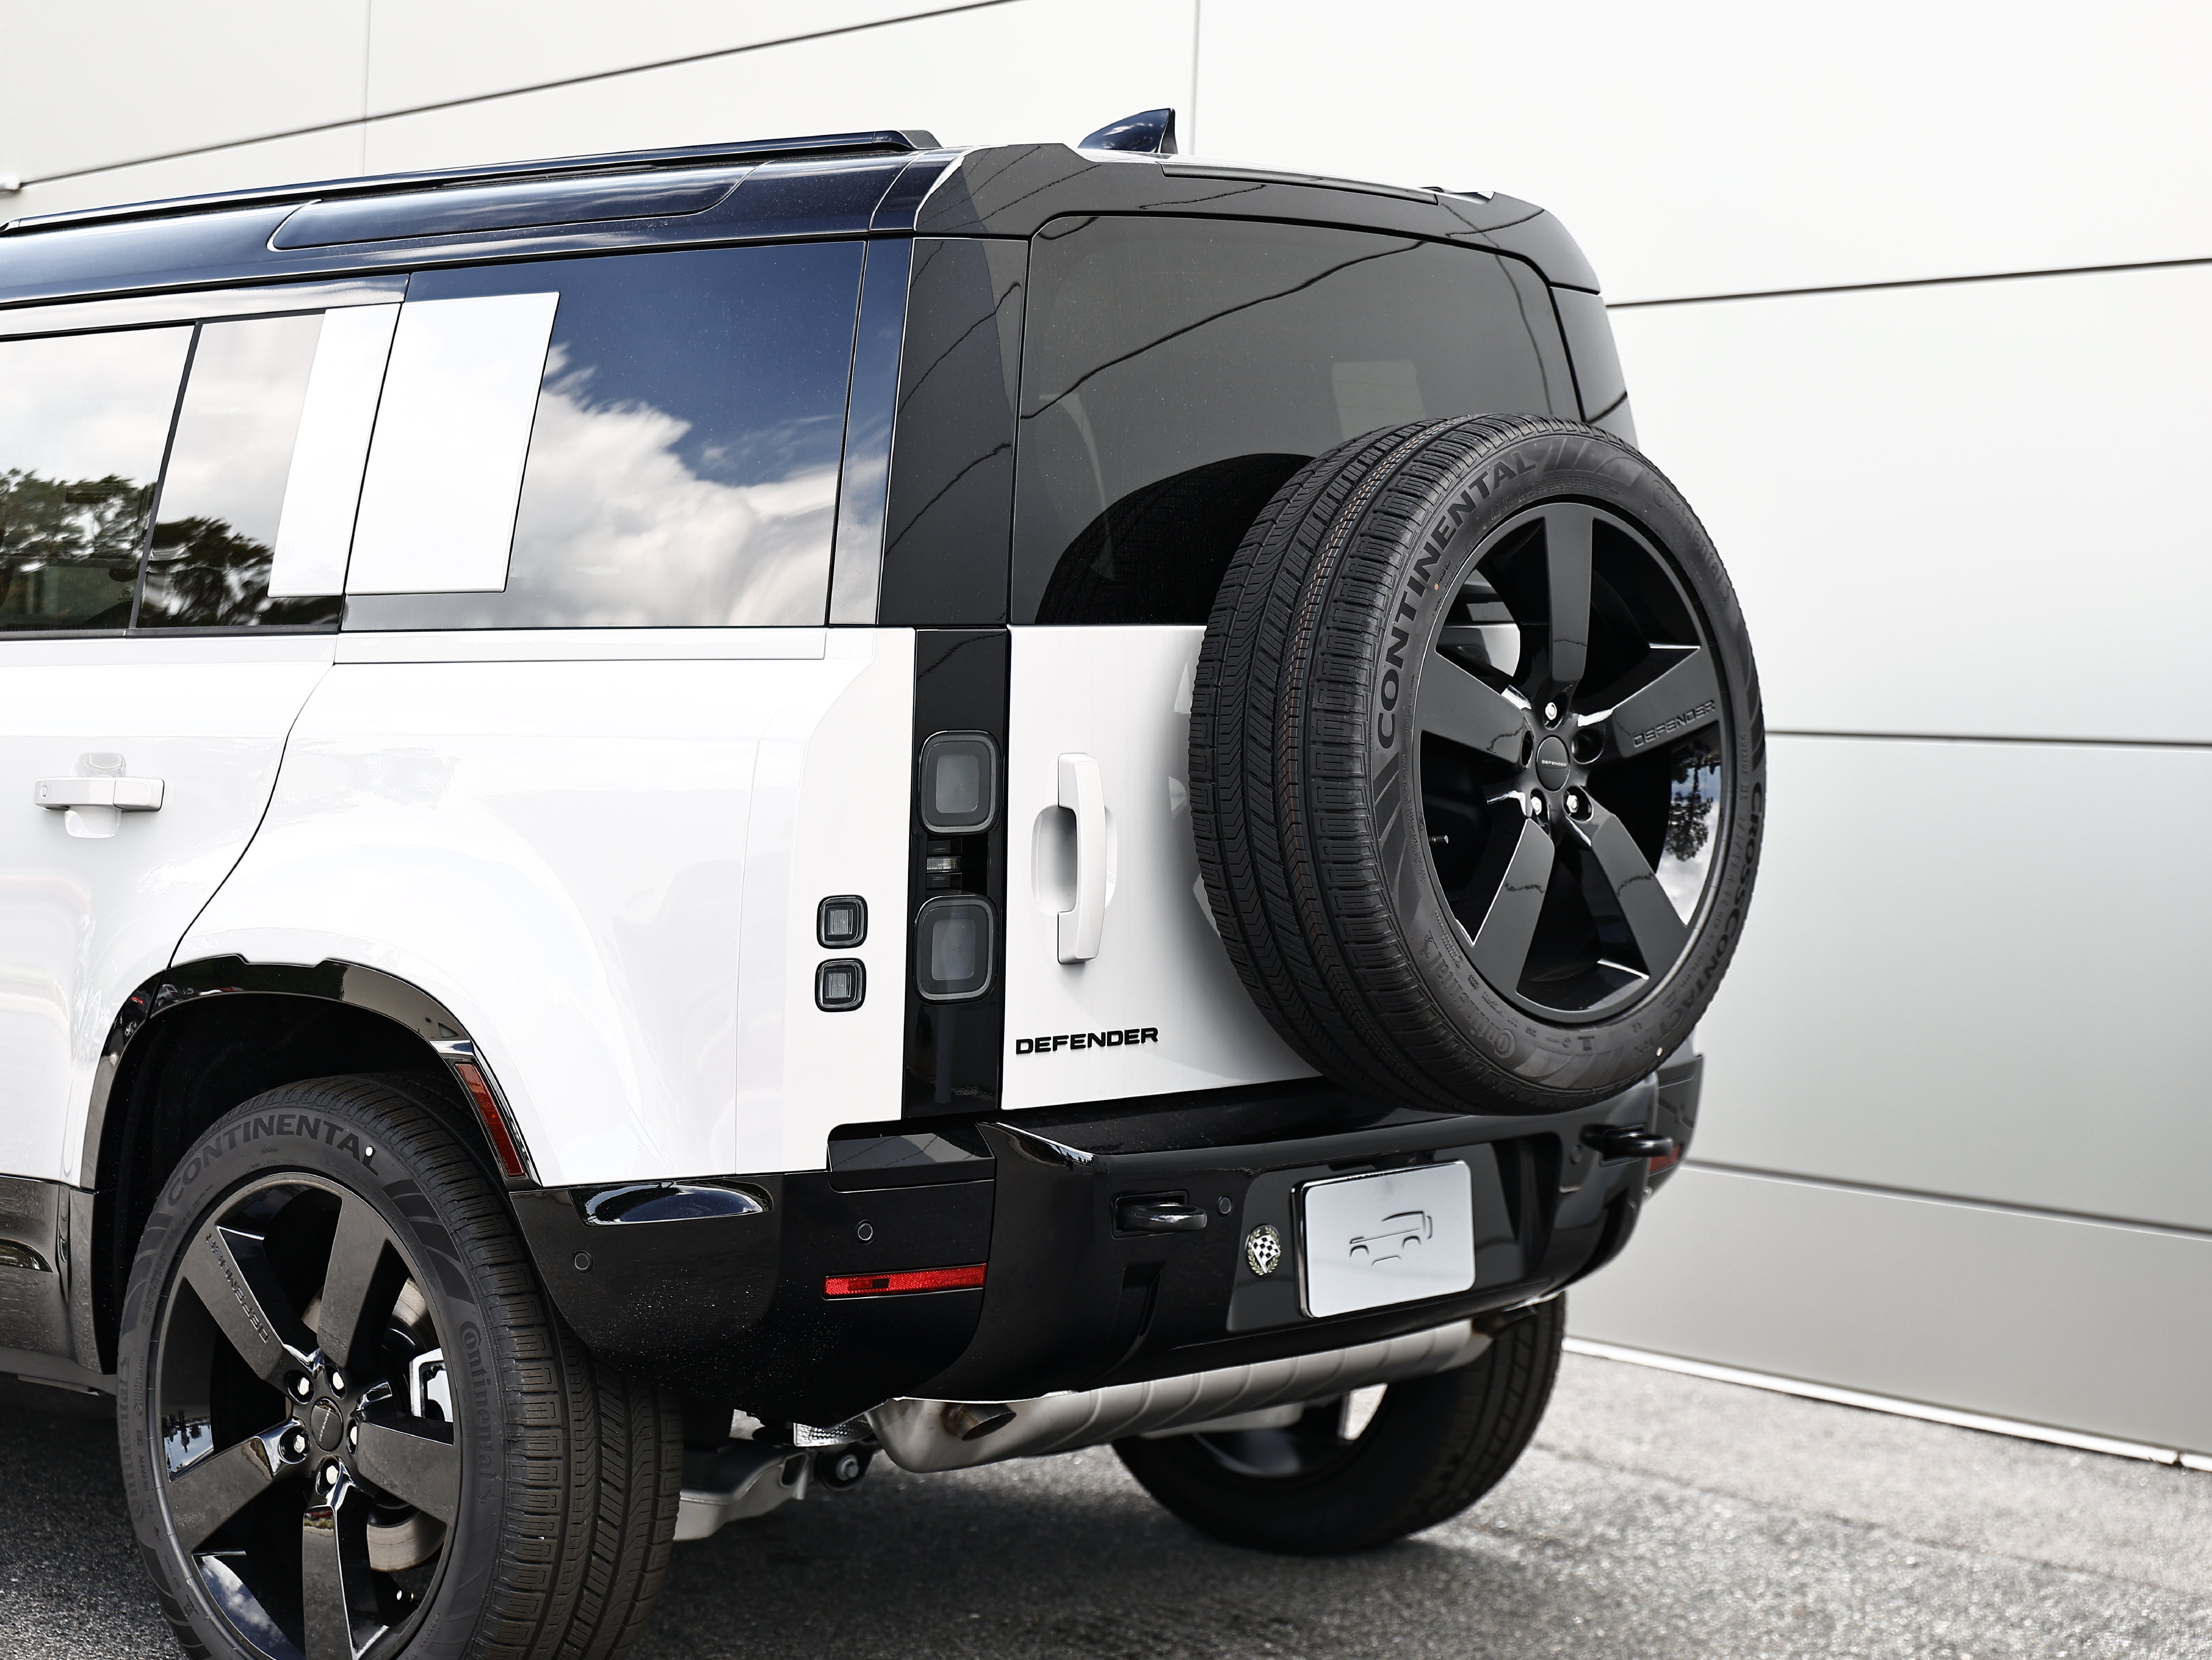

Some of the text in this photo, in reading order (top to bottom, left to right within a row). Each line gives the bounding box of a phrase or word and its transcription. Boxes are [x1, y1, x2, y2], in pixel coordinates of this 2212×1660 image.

[1378, 451, 1536, 749] CONTINENTAL
[1633, 699, 1716, 748] DEFENDER
[1016, 1027, 1159, 1055] DEFENDER
[168, 1114, 378, 1208] CONTINENTAL
[206, 1233, 271, 1343] DEFENDER
[319, 1408, 332, 1442] DEFENDER
[459, 1321, 497, 1481] Continental
